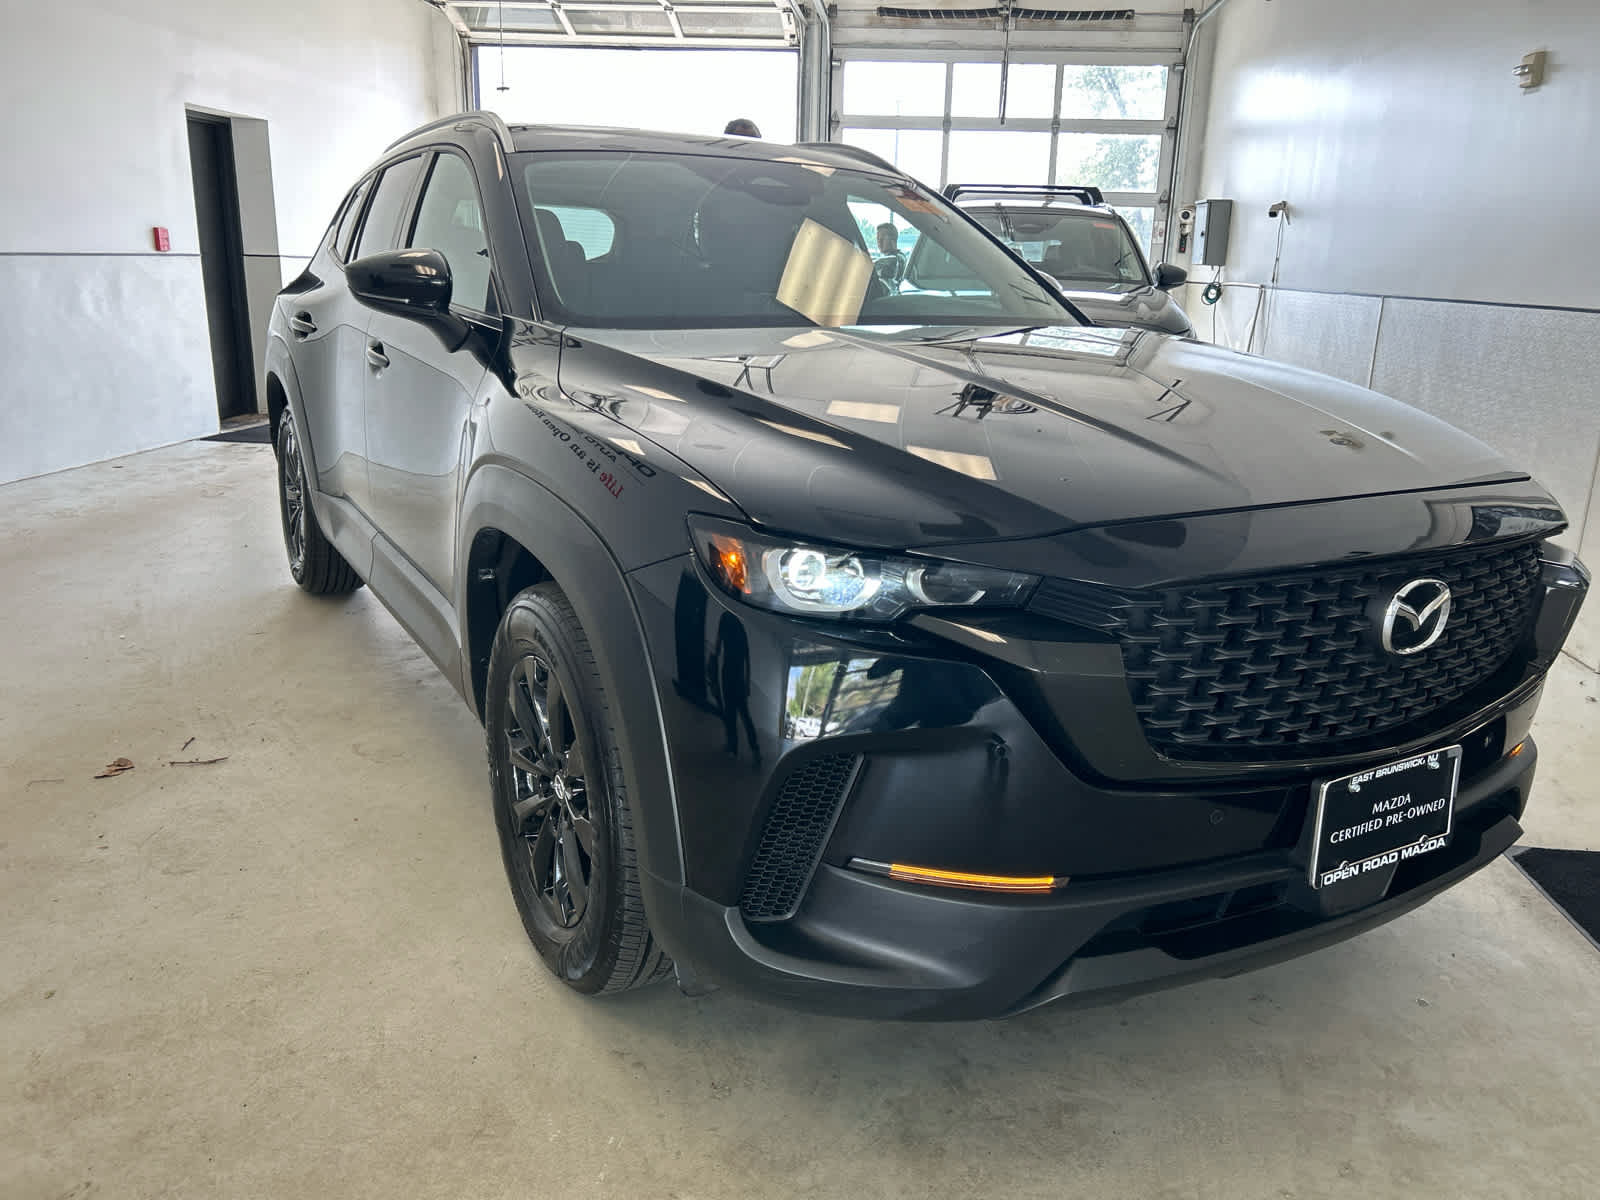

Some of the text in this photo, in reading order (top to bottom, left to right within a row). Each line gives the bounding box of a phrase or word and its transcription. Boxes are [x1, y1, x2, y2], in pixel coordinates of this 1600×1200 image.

[1352, 772, 1375, 785] EAST
[1427, 753, 1439, 764] NJ
[1330, 798, 1446, 844] CERTIFIED PRE-OWNED
[1372, 793, 1411, 815] MAZDA
[1323, 838, 1446, 886] OPEN ROAD MAZDA
